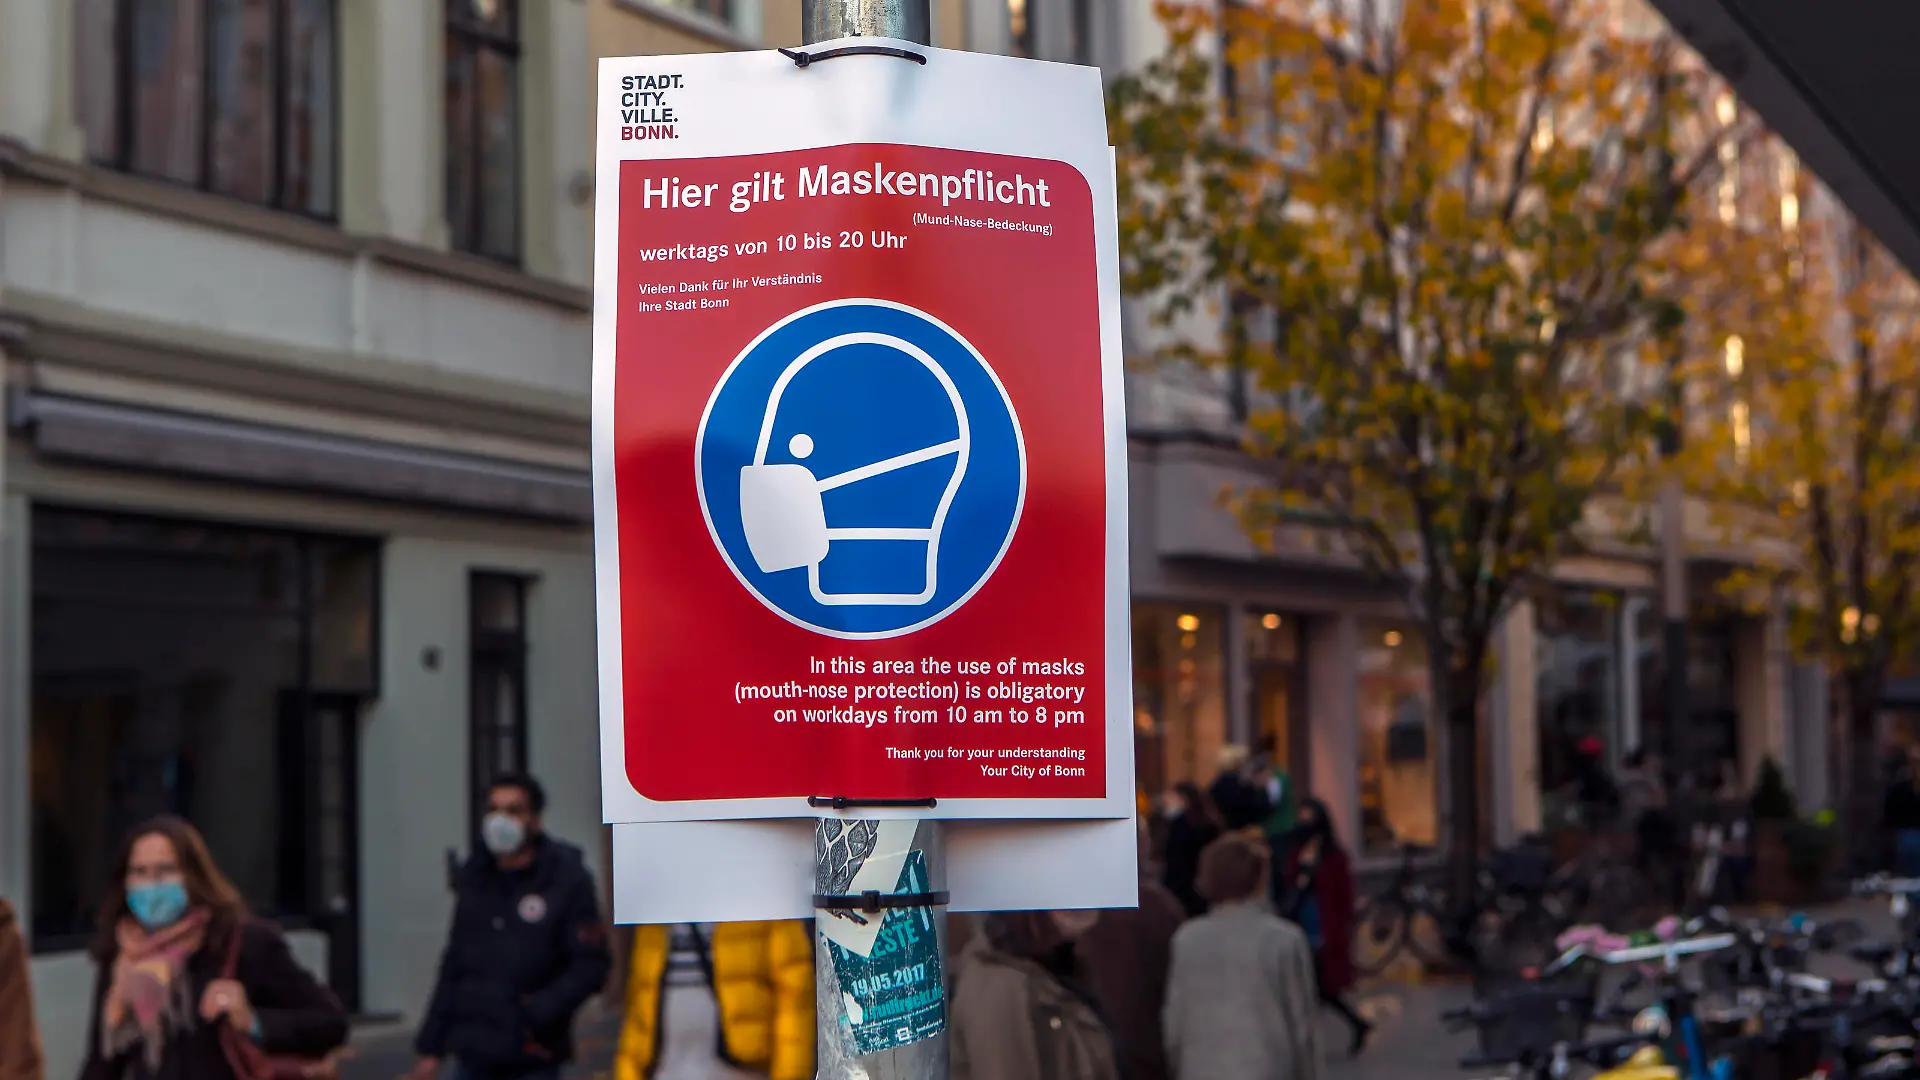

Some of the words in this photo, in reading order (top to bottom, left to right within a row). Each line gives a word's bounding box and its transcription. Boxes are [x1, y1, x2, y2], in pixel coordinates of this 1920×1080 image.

[621, 74, 684, 91] STADT.
[621, 91, 666, 108] CITY.
[620, 108, 679, 124] VILLE.
[621, 124, 679, 141] BONN.
[643, 176, 719, 209] Hier
[729, 170, 785, 213] gilt
[798, 162, 1051, 208] Maskenpflicht
[912, 212, 1053, 237] (Mund-Nase-Bedeckung)
[639, 243, 729, 263] werktags
[734, 240, 768, 256] von
[776, 234, 797, 252] 10
[803, 231, 832, 250] bis
[839, 230, 864, 249] 20
[871, 230, 908, 249] Uhr
[638, 283, 676, 295] Vielen
[679, 280, 709, 293] Dank
[711, 279, 730, 291] für
[732, 277, 749, 289] Ihr
[750, 271, 823, 287] Verständnis
[638, 301, 663, 313] Ihre
[664, 298, 697, 311] Stadt
[700, 297, 730, 309] Bonn
[810, 655, 825, 674] In
[830, 655, 866, 674] this
[872, 660, 915, 674] area
[920, 656, 952, 675] the
[957, 661, 991, 675] use
[996, 657, 1017, 675] of
[1022, 657, 1085, 676] masks
[734, 680, 848, 704] (mouth-nose
[854, 681, 959, 704] protection)
[965, 681, 981, 699] is
[987, 681, 1086, 704] obligatory
[773, 709, 797, 723] on
[801, 705, 888, 729] workdays
[893, 705, 938, 724] from
[946, 705, 967, 724] 10
[973, 709, 1003, 724] am
[1008, 707, 1029, 724] to
[1035, 706, 1047, 724] 8
[1054, 710, 1085, 728] pm
[885, 746, 922, 759] Thank
[923, 749, 944, 761] you
[946, 746, 965, 758] for
[967, 749, 995, 761] your
[997, 746, 1086, 761] understanding
[980, 764, 1009, 777] Your
[1011, 764, 1035, 779] City
[1038, 764, 1052, 777] of
[1054, 764, 1085, 777] Bonn
[851, 963, 925, 997] 19.05.2017
